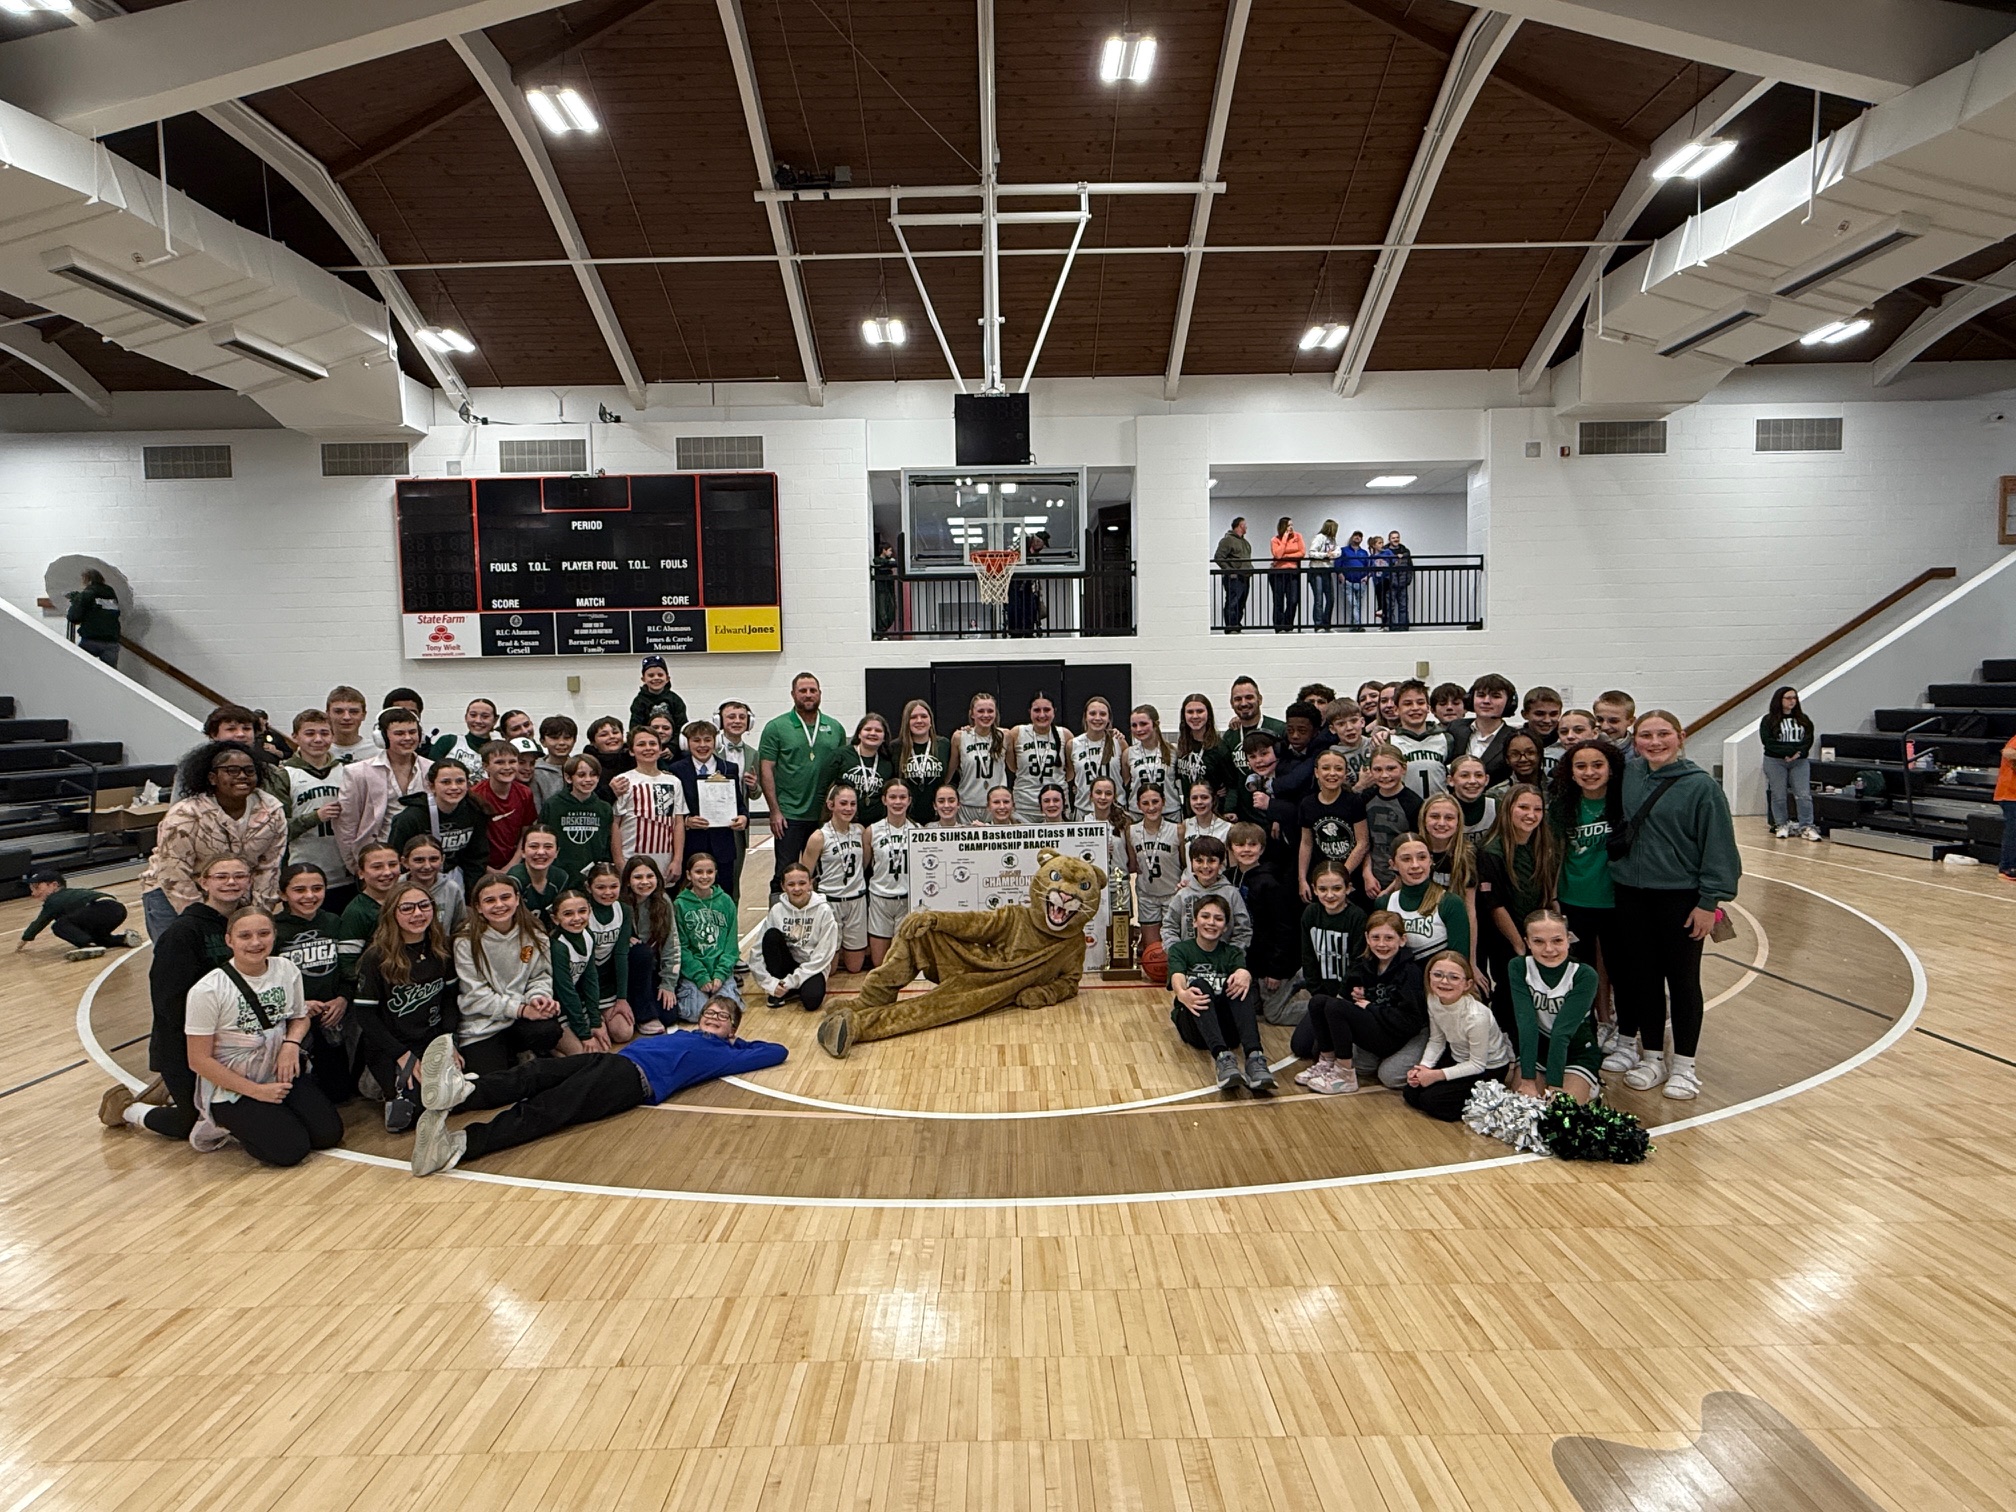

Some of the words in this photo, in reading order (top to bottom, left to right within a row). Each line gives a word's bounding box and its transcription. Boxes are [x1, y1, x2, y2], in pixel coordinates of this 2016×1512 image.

[571, 521, 602, 530] PERIOD
[490, 562, 517, 572] FOULS
[528, 562, 551, 571] T.O.L.
[562, 561, 593, 570] PLAYER
[596, 561, 618, 570] FOUL
[628, 560, 650, 569] T.O.L.
[661, 559, 688, 569] FOULS
[492, 599, 519, 608] SCORE
[576, 597, 605, 607] MATCH
[662, 596, 689, 605] SCORE
[507, 646, 530, 654] Gesell
[522, 740, 530, 748] S
[1404, 750, 1443, 763] MITHTON
[974, 756, 993, 779] 10
[1028, 754, 1054, 777] 32
[1419, 770, 1430, 799] 1
[297, 786, 340, 806] SMITHT
[561, 816, 600, 826] BASKETBALL
[912, 832, 937, 842] 2026
[940, 830, 980, 842] SIJHSAA
[982, 829, 1035, 840] Basketball
[1038, 828, 1064, 838] Class
[1067, 828, 1075, 837] M
[1077, 826, 1104, 837] STATE
[958, 840, 1022, 851] CHAMPIONSHIP
[1024, 840, 1060, 850] BRACKET
[1404, 916, 1432, 938] GARS
